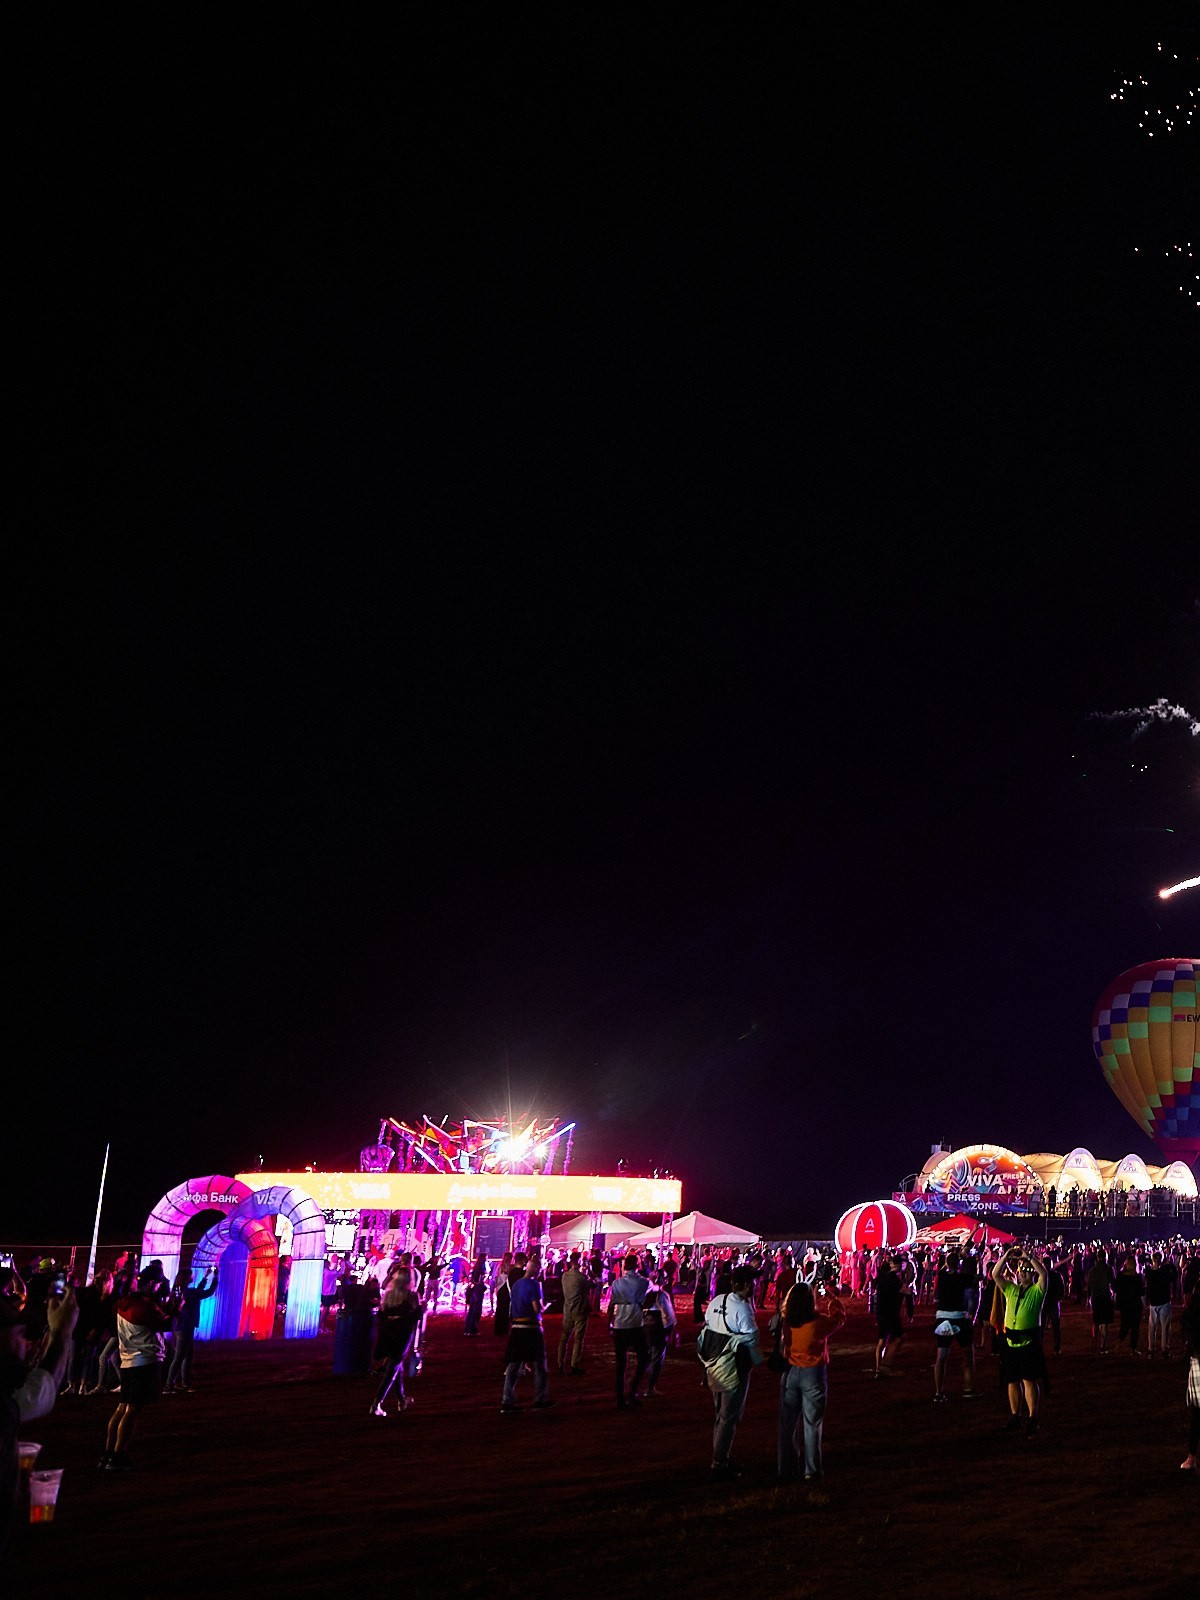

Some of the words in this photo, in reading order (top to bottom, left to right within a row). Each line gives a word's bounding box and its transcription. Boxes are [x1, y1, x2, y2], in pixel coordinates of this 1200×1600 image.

[967, 1174, 1004, 1187] VIVA
[210, 1192, 239, 1204] Банк
[947, 1193, 981, 1202] PRESS
[970, 1202, 999, 1211] ZONE
